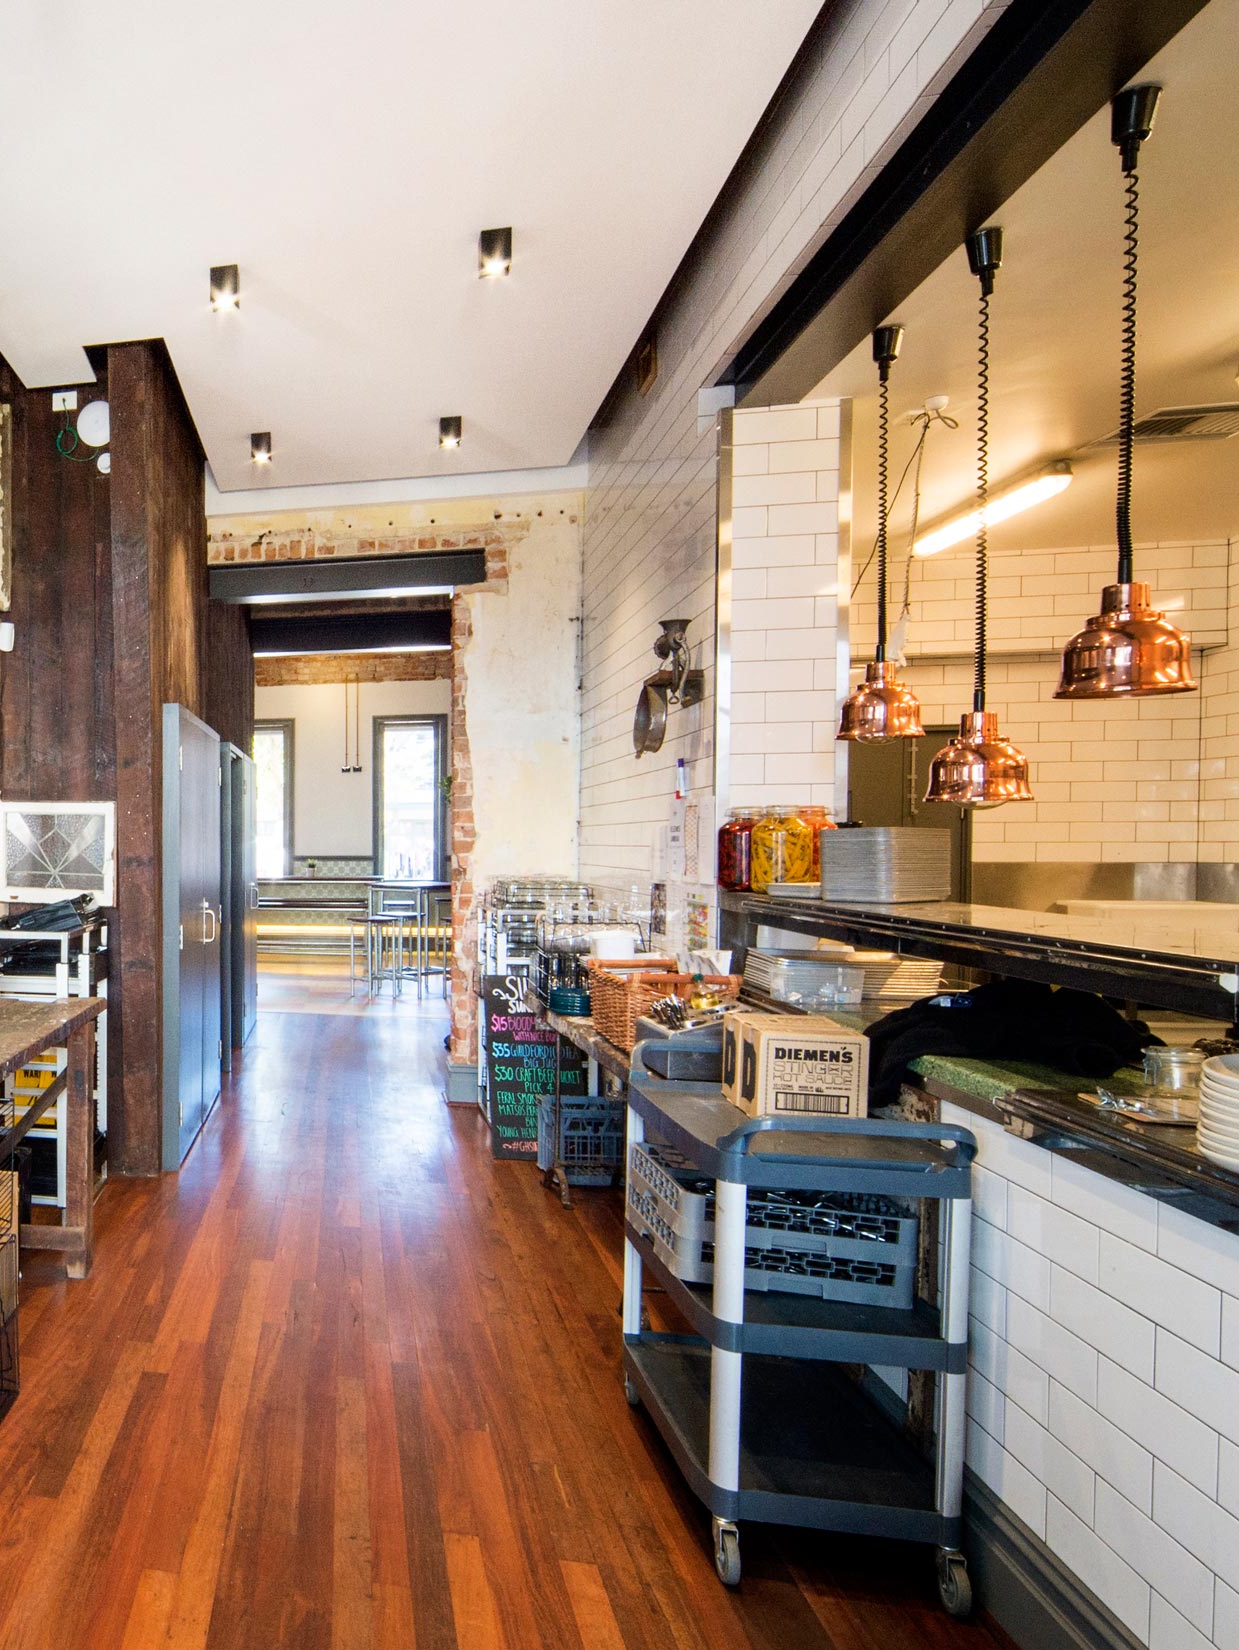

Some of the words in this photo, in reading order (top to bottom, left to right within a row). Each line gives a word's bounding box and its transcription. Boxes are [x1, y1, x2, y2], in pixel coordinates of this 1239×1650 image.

[491, 1013, 508, 1032] $15
[492, 1041, 511, 1058] $35
[774, 1047, 853, 1063] DIEMEN'S
[494, 1064, 514, 1082] $30
[515, 1066, 537, 1082] CRAFT
[773, 1061, 854, 1077] STINGER
[773, 1072, 801, 1083] HOT
[805, 1074, 853, 1086] SAUCE
[524, 1082, 543, 1094] PICK
[546, 1083, 555, 1093] 4
[497, 1091, 517, 1104] FERAL
